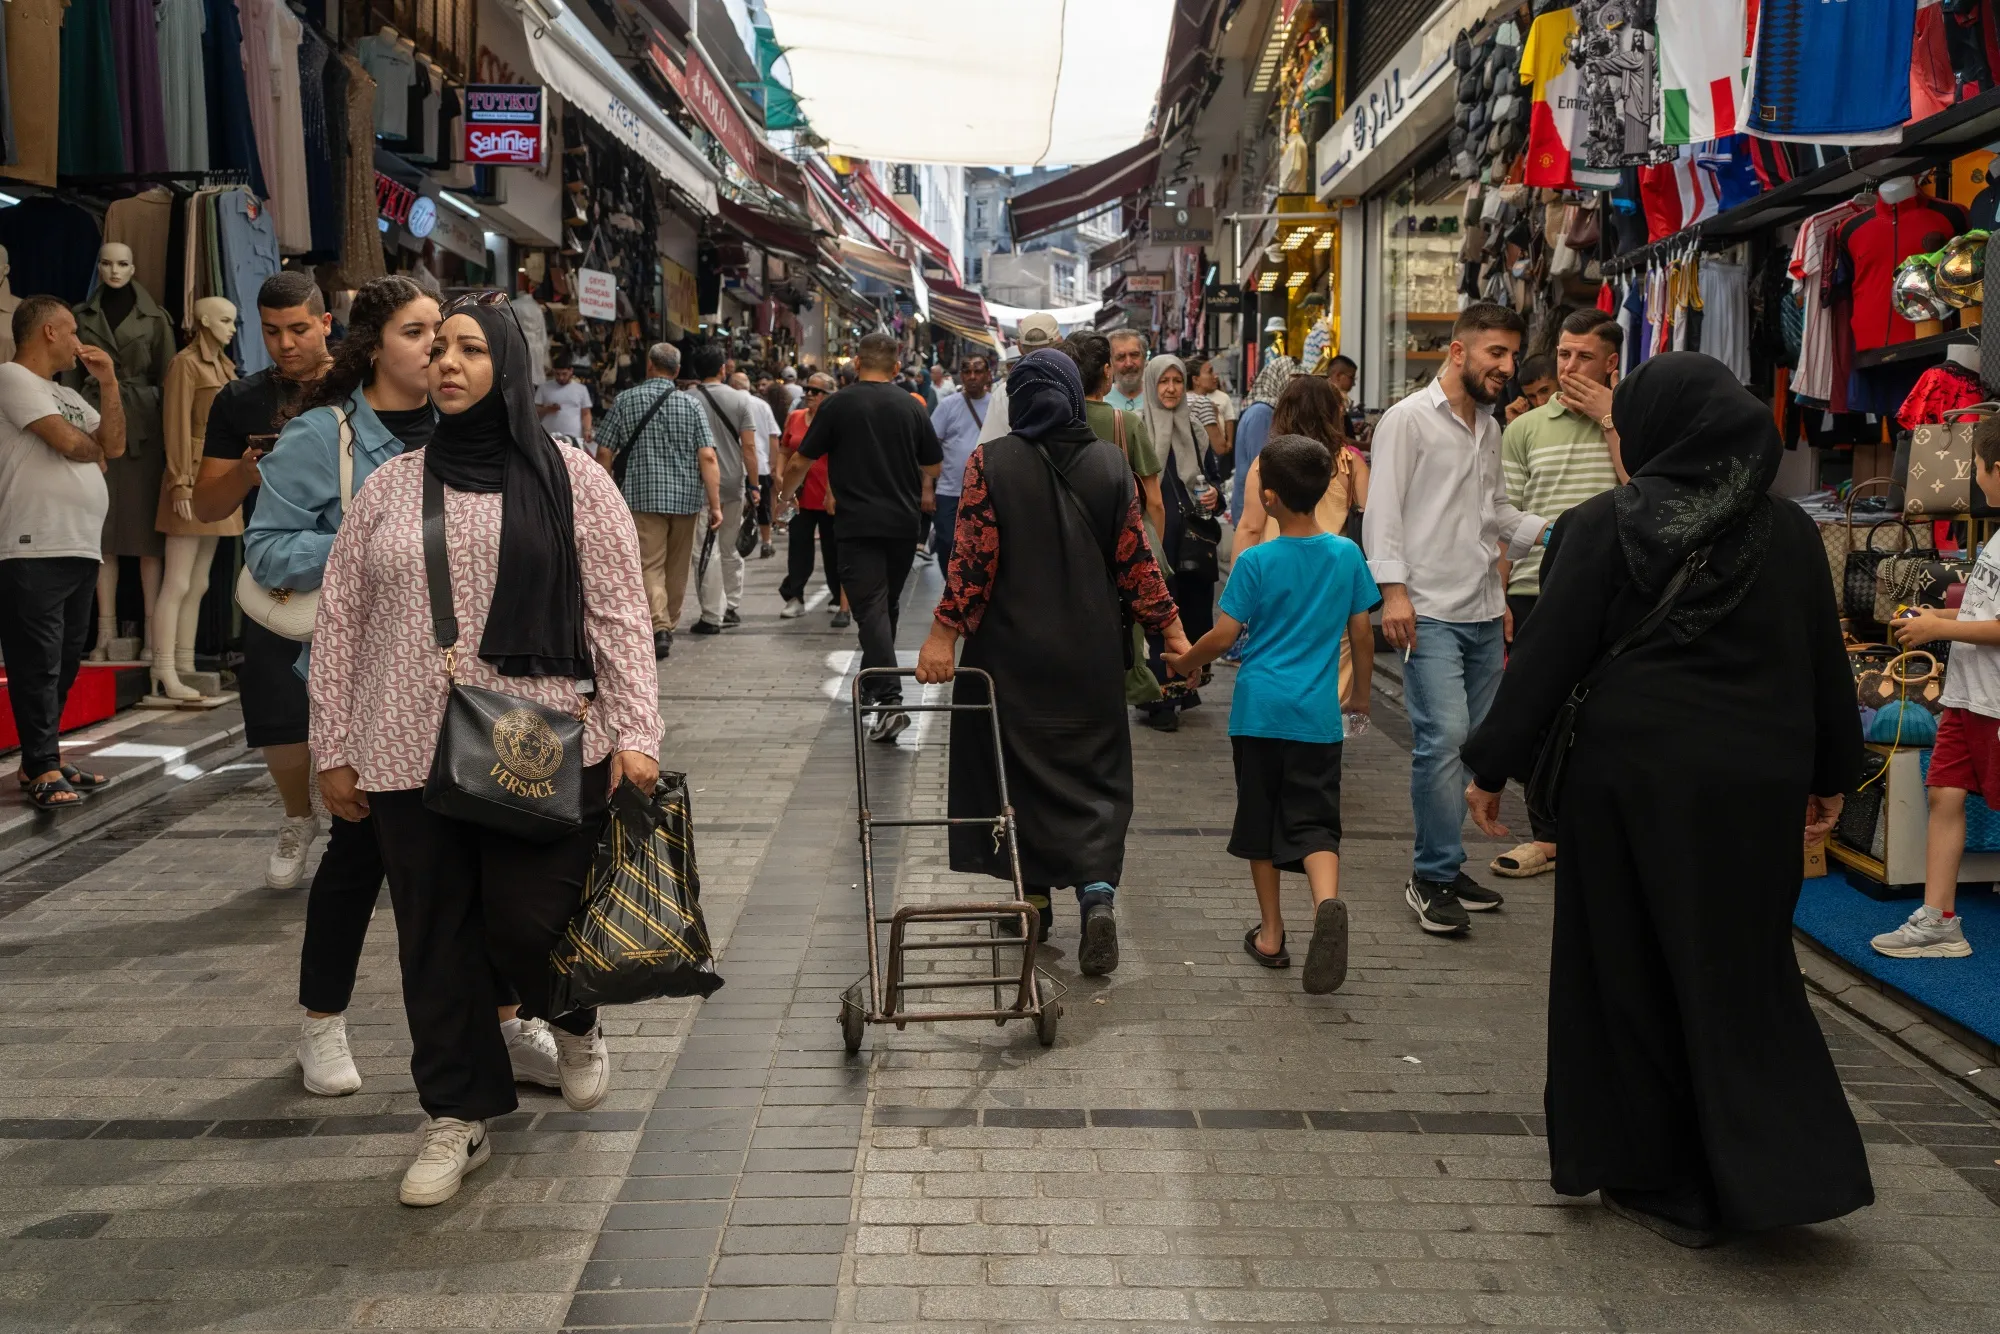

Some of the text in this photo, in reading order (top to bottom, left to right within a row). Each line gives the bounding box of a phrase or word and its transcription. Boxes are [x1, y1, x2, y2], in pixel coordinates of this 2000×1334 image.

[467, 91, 539, 112] TUTKU
[702, 79, 728, 133] POLO
[1557, 95, 1590, 111] Emira
[490, 762, 557, 798] VERSACE
